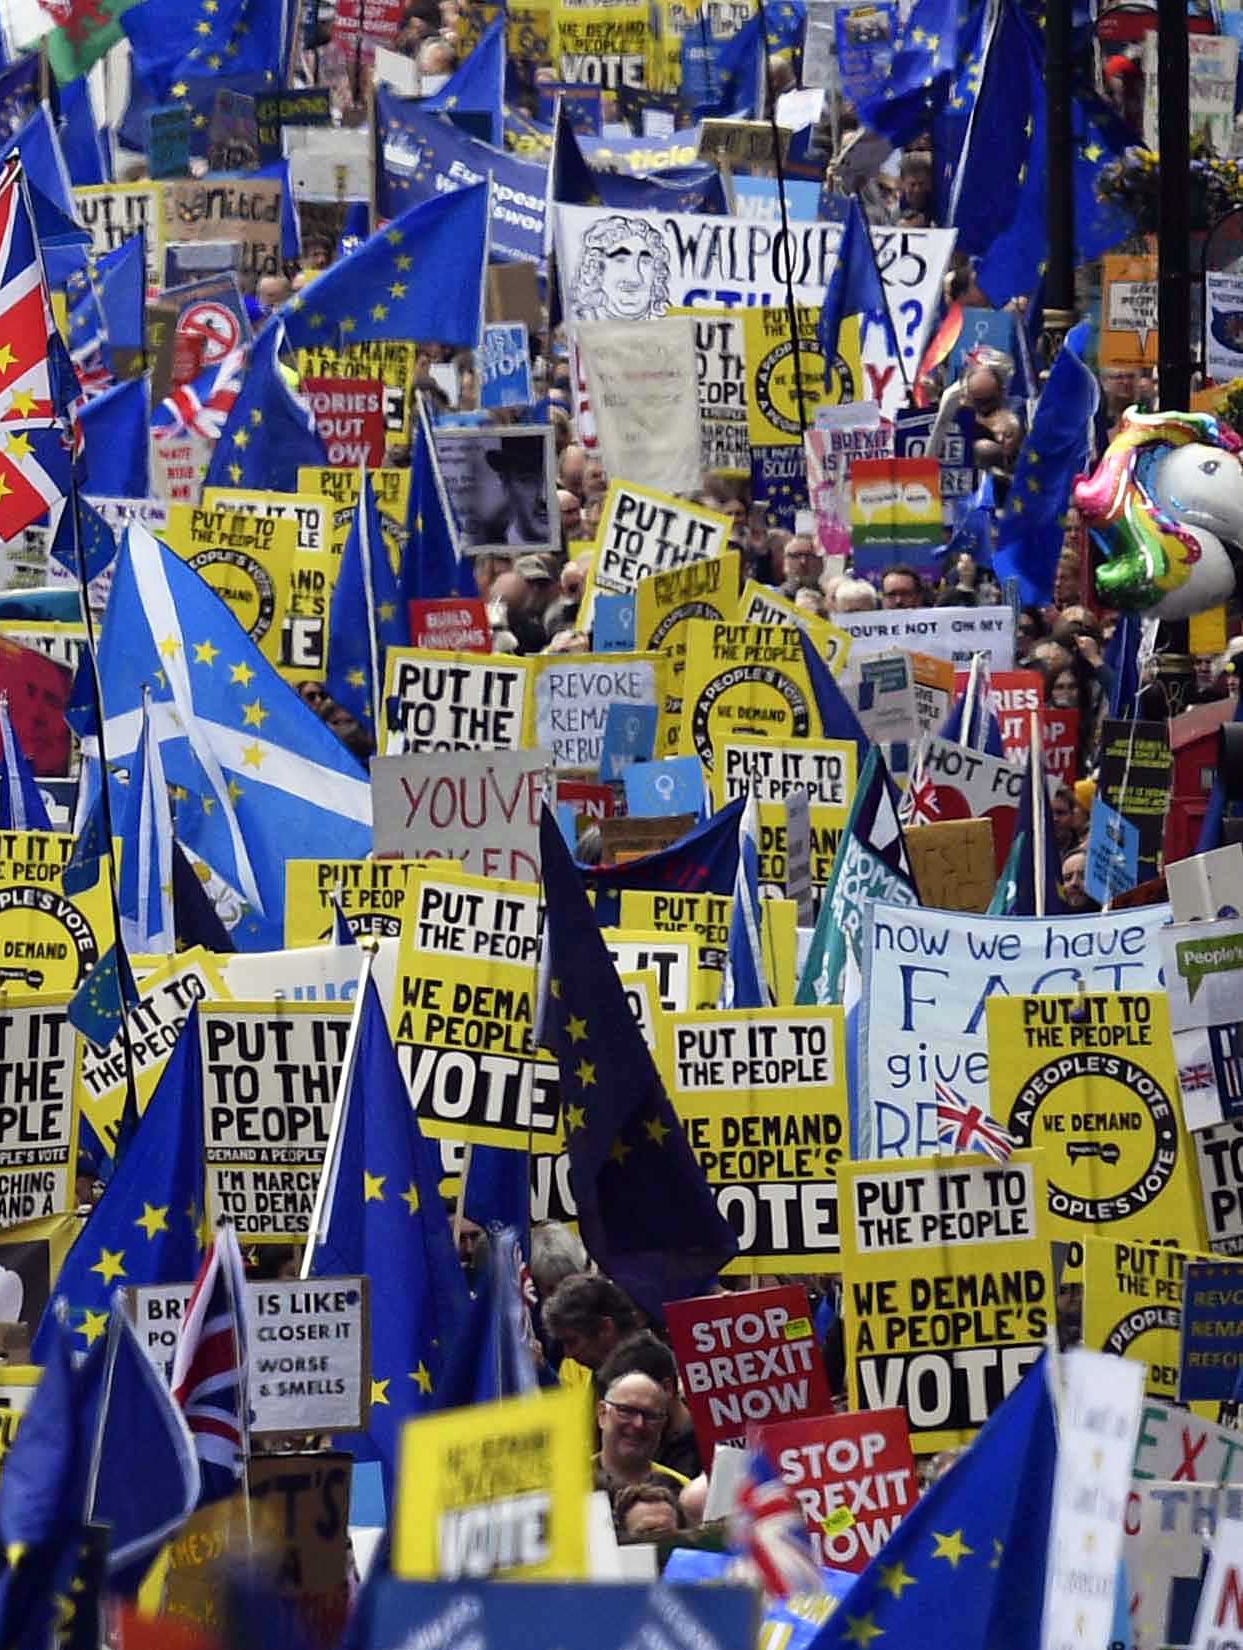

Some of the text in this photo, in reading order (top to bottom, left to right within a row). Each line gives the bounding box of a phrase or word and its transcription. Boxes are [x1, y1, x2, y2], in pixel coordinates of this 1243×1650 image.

[561, 56, 644, 88] VOTE
[191, 510, 226, 534] PUT
[254, 517, 276, 538] TO
[191, 527, 225, 544] THE
[615, 493, 717, 549] PUT IT
[613, 523, 645, 558] TO
[713, 625, 749, 646] PUT
[905, 621, 937, 635] NOT
[743, 645, 802, 662] PEOPLE
[399, 663, 518, 706] PUT IT
[549, 672, 643, 699] REVOKE
[449, 705, 514, 743] THE
[810, 747, 841, 778] TO
[924, 743, 983, 782] HOT
[26, 834, 45, 861] IT
[318, 864, 393, 887] PUT IT
[420, 887, 525, 932] PUT IT
[653, 896, 697, 922] PUT
[4, 942, 69, 962] DEMAND
[418, 922, 465, 951] THE
[874, 922, 1147, 961] now we have
[164, 972, 207, 1003] TO
[402, 975, 444, 1008] WE
[1023, 996, 1151, 1025] PUT TO
[28, 1012, 67, 1060] IT
[207, 1020, 293, 1062] PUT
[677, 1024, 826, 1061] PUT IT TO
[1025, 1025, 1153, 1049] THE PEOPLE
[678, 1057, 828, 1086] THE PEOPLE
[887, 1042, 988, 1089] give
[209, 1065, 259, 1105] TO
[396, 1043, 559, 1134] VOTE
[1023, 1055, 1170, 1121] PEOPLE'S VOTE
[719, 1113, 842, 1148] DEMAND
[1071, 1112, 1143, 1133] DEMAND
[37, 1147, 67, 1163] VOTE
[207, 1148, 257, 1163] DEMAND
[859, 1168, 1028, 1216] PUT IT TO
[1133, 1149, 1176, 1204] VOTE
[42, 1196, 54, 1215] A
[219, 1192, 247, 1213] TO
[859, 1209, 1030, 1248] THE PEOPLE
[1116, 1243, 1163, 1279] PUT
[853, 1270, 1046, 1316] WE DEMAND
[1117, 1273, 1149, 1298] THE
[258, 1291, 347, 1316] IS LIKE
[257, 1322, 352, 1343] CLOSER IT
[690, 1306, 790, 1354] STOP
[857, 1307, 1048, 1352] A PEOPLE'S
[684, 1339, 815, 1394] BREXIT
[278, 1377, 346, 1397] SMELLS
[707, 1378, 808, 1428] NOW
[779, 1432, 887, 1486] STOP
